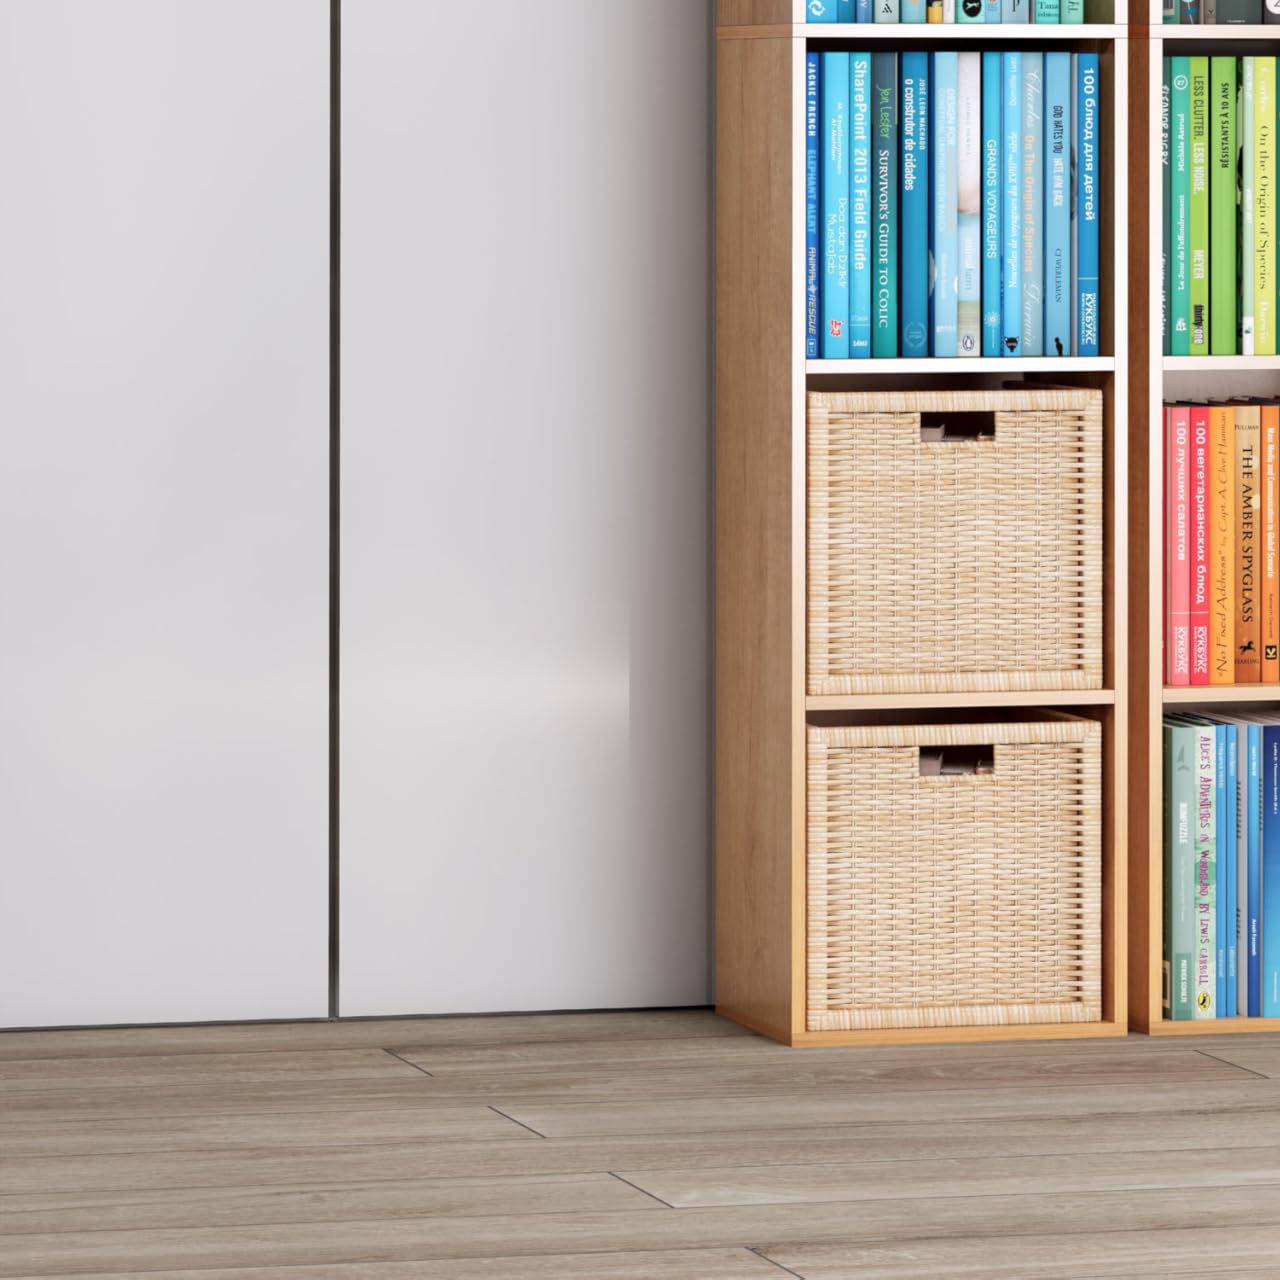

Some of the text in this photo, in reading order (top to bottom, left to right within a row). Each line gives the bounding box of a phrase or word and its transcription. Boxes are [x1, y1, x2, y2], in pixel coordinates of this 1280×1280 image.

[808, 62, 816, 136] JACKIE FRENCH
[854, 61, 867, 270] SharePoint 2013 Field Guide
[1084, 68, 1095, 220] 100 блюд для детей
[987, 140, 996, 258] GRANDS VOYAGEURS
[1194, 250, 1204, 279] MEYER
[1257, 126, 1270, 290] On the Origin of Species
[1177, 420, 1186, 560] 100 лучших салатов
[1196, 420, 1206, 603] 100 вегетарианских блюд
[1242, 445, 1253, 622] THE AMBER SPYGLASS
